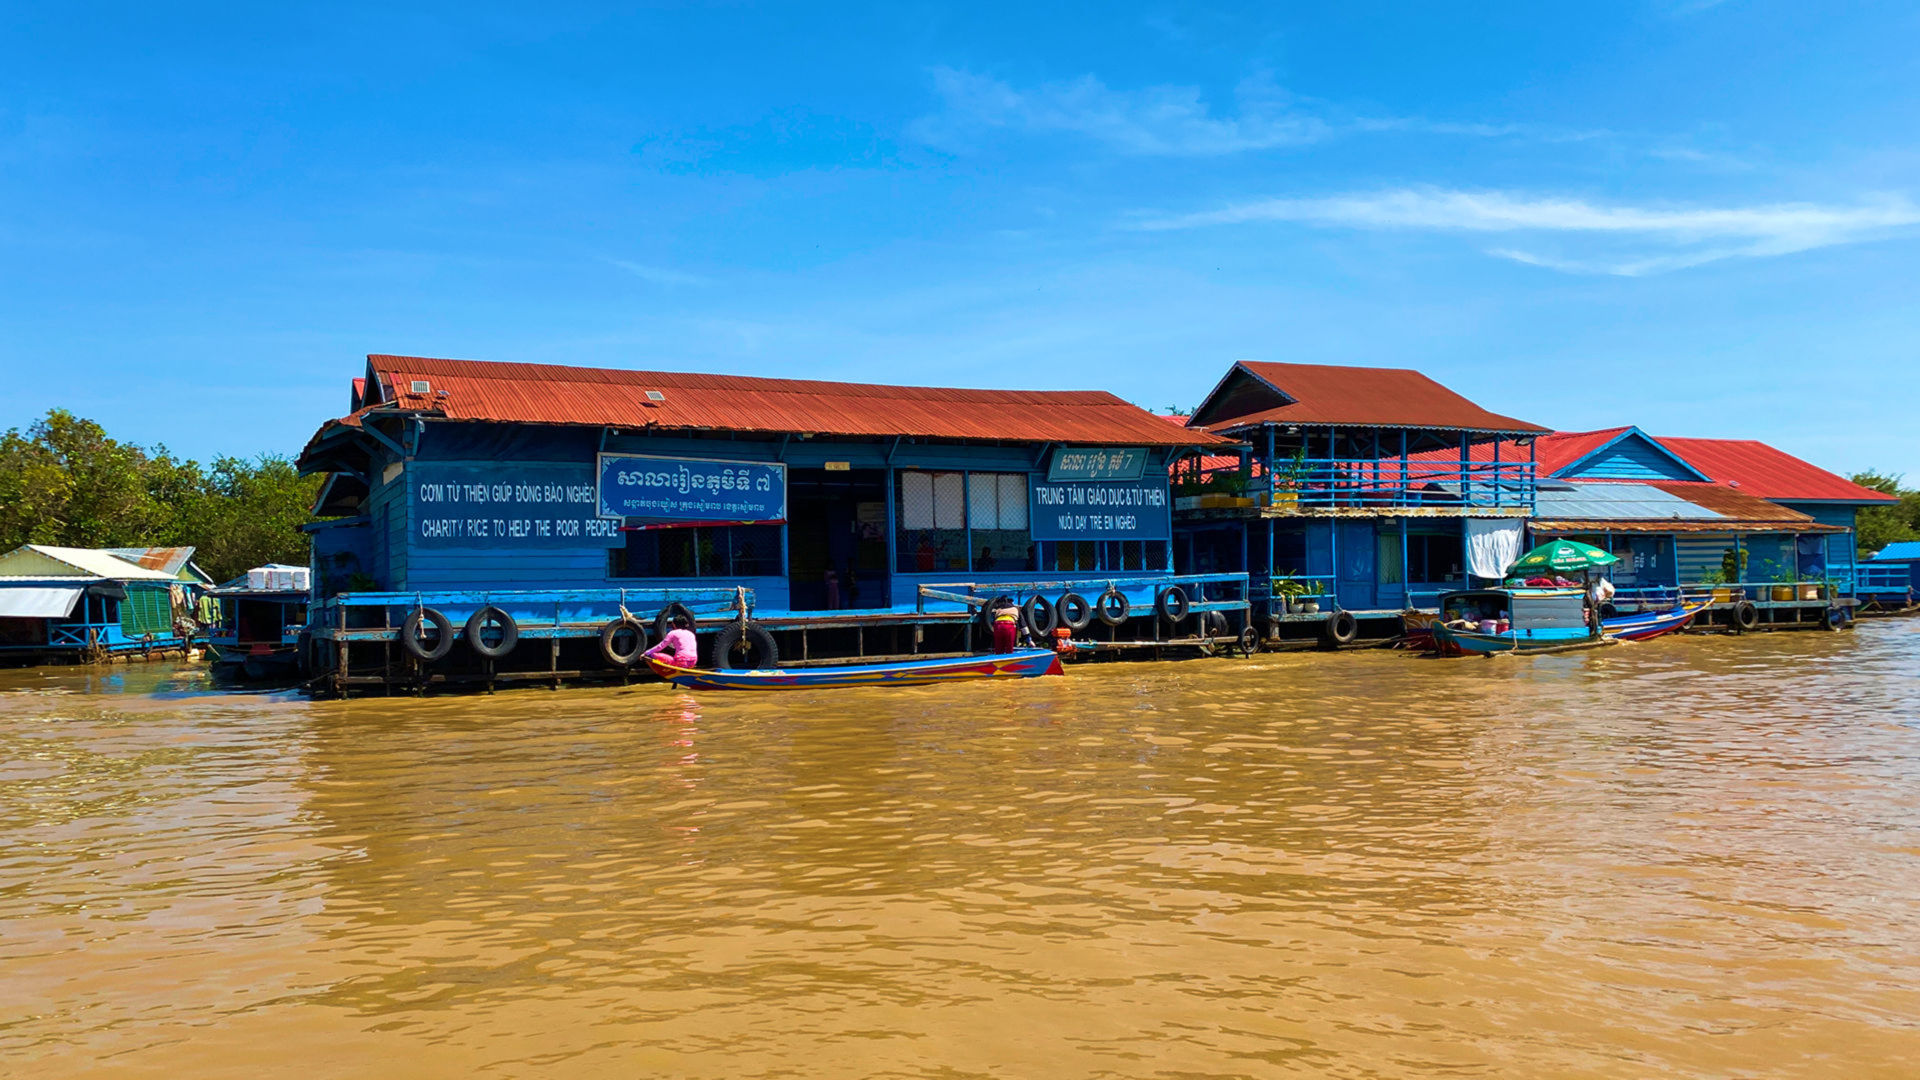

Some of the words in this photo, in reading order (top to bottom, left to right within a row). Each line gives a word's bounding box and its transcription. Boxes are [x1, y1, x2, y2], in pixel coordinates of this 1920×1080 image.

[1124, 454, 1133, 470] 7
[420, 483, 443, 502] CƠM
[492, 481, 513, 502] GIÚP
[544, 481, 564, 503] BÀO
[756, 474, 770, 492] ៧
[1035, 487, 1065, 505] TRUNG
[1067, 483, 1085, 505] TÂM
[1087, 484, 1107, 505] GIÁO
[421, 519, 463, 537] CHARITY
[467, 519, 488, 537] RICE
[494, 519, 506, 537] TO
[508, 519, 531, 537] HELP
[535, 519, 551, 537] THE
[556, 520, 579, 537] POOR
[585, 520, 618, 537] PEOPLE
